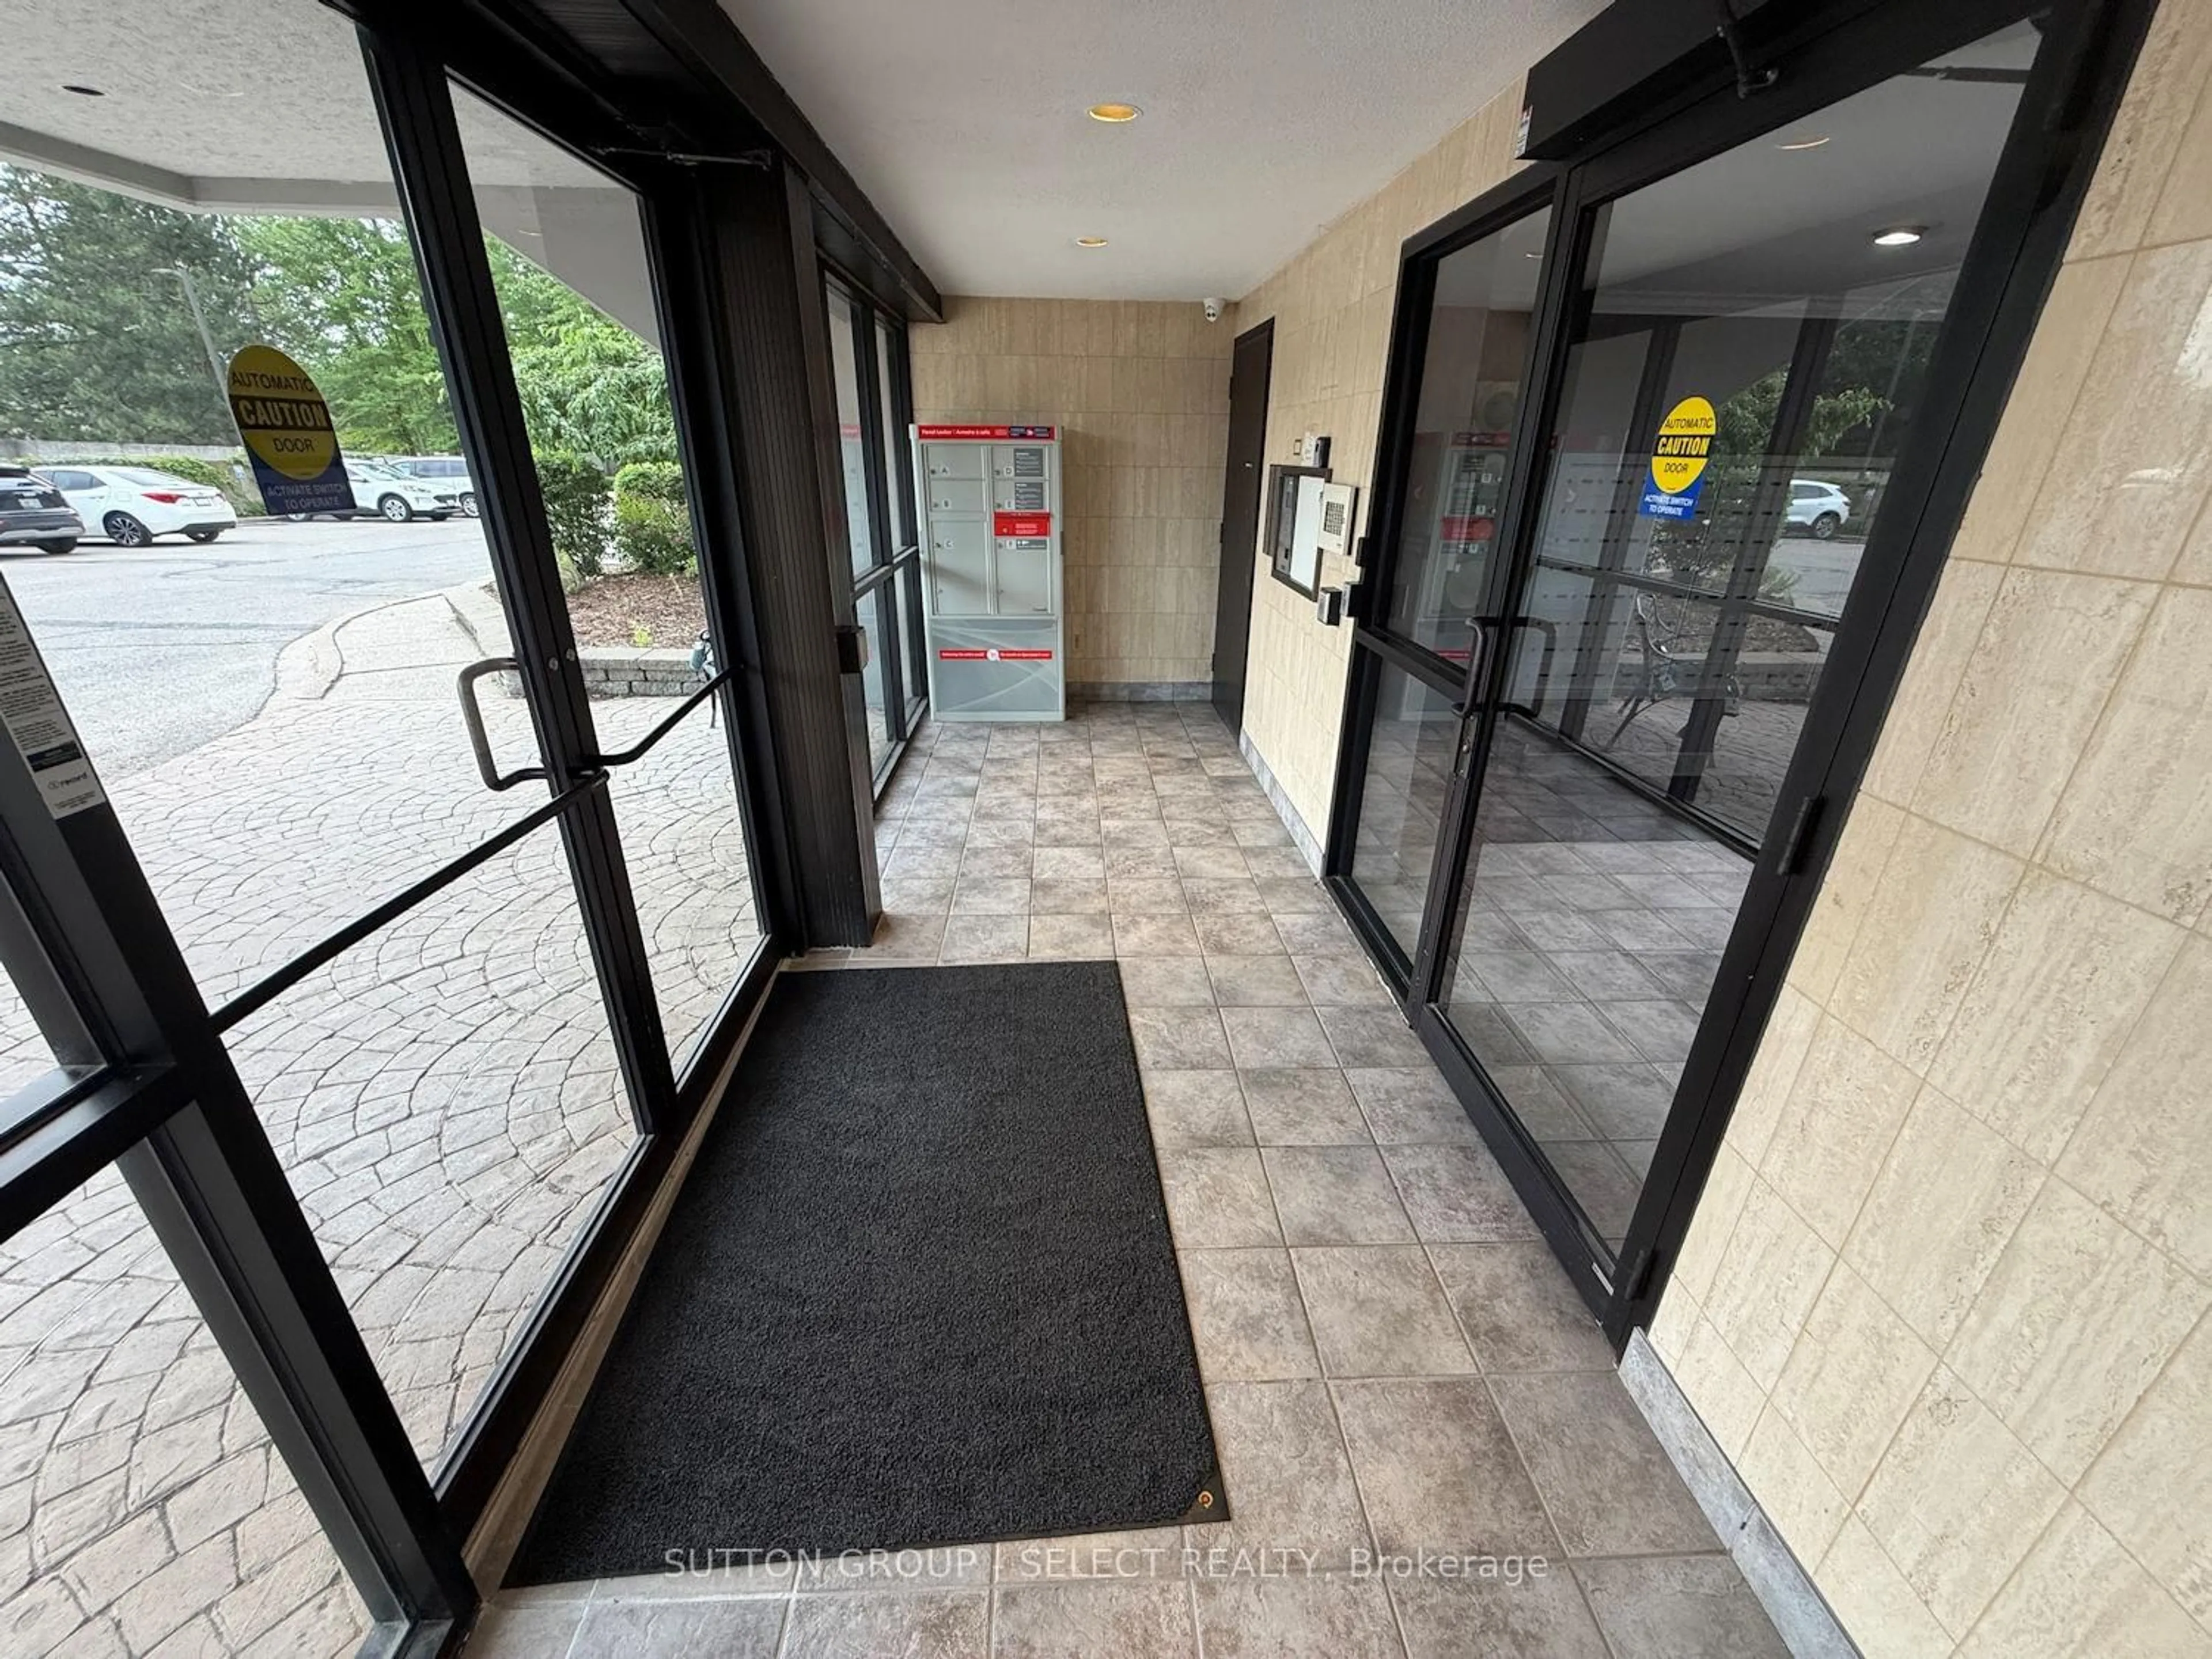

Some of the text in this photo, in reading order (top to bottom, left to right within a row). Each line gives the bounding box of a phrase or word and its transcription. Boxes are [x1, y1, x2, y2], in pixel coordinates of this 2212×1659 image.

[232, 373, 313, 392] AUTOMATIC
[238, 399, 328, 427] CAUTION
[1664, 417, 1713, 429] AUTOMATIC
[273, 438, 315, 453] DOOR
[1657, 436, 1710, 456] CAUTION
[1664, 463, 1688, 473] DOOR
[285, 498, 298, 510] TO
